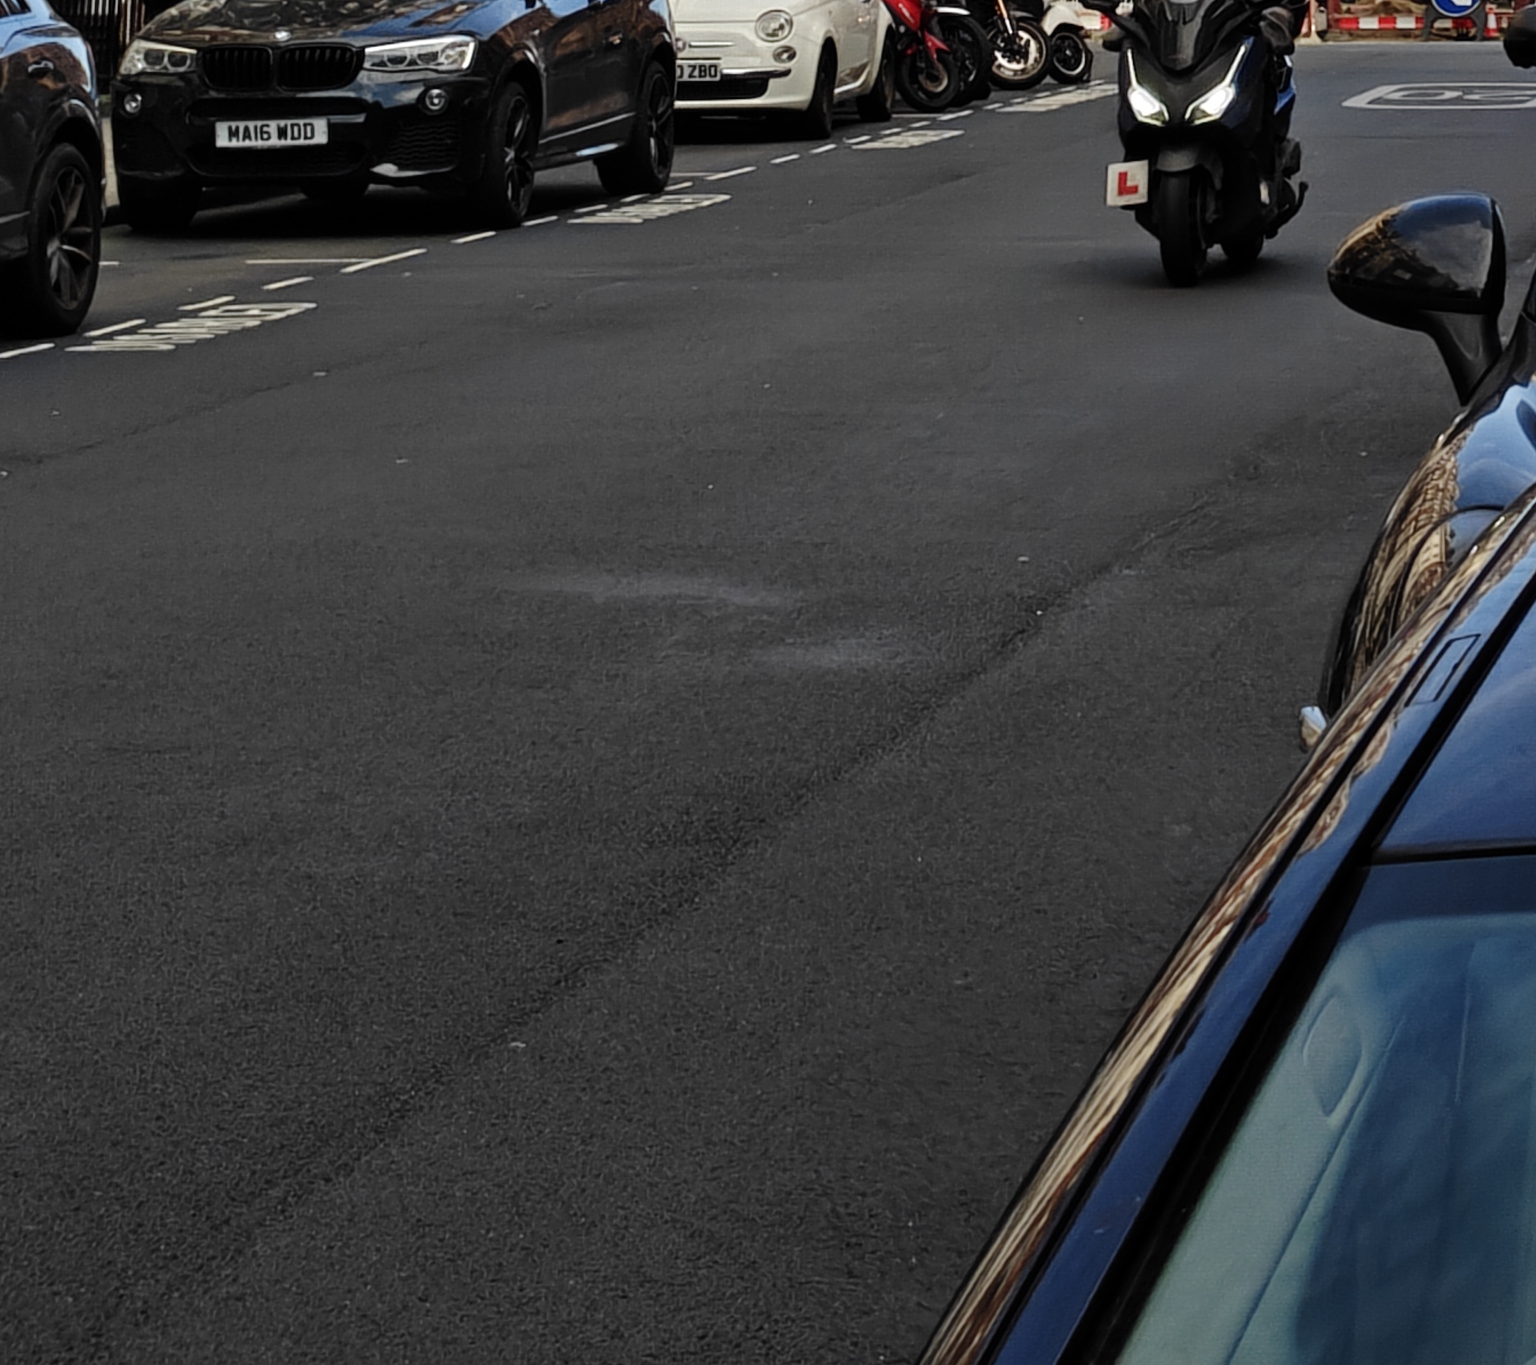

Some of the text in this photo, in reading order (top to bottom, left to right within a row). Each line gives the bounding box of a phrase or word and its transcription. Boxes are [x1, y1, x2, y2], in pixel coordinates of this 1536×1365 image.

[227, 122, 315, 142] MA16 WDD
[1118, 172, 1139, 196] L
